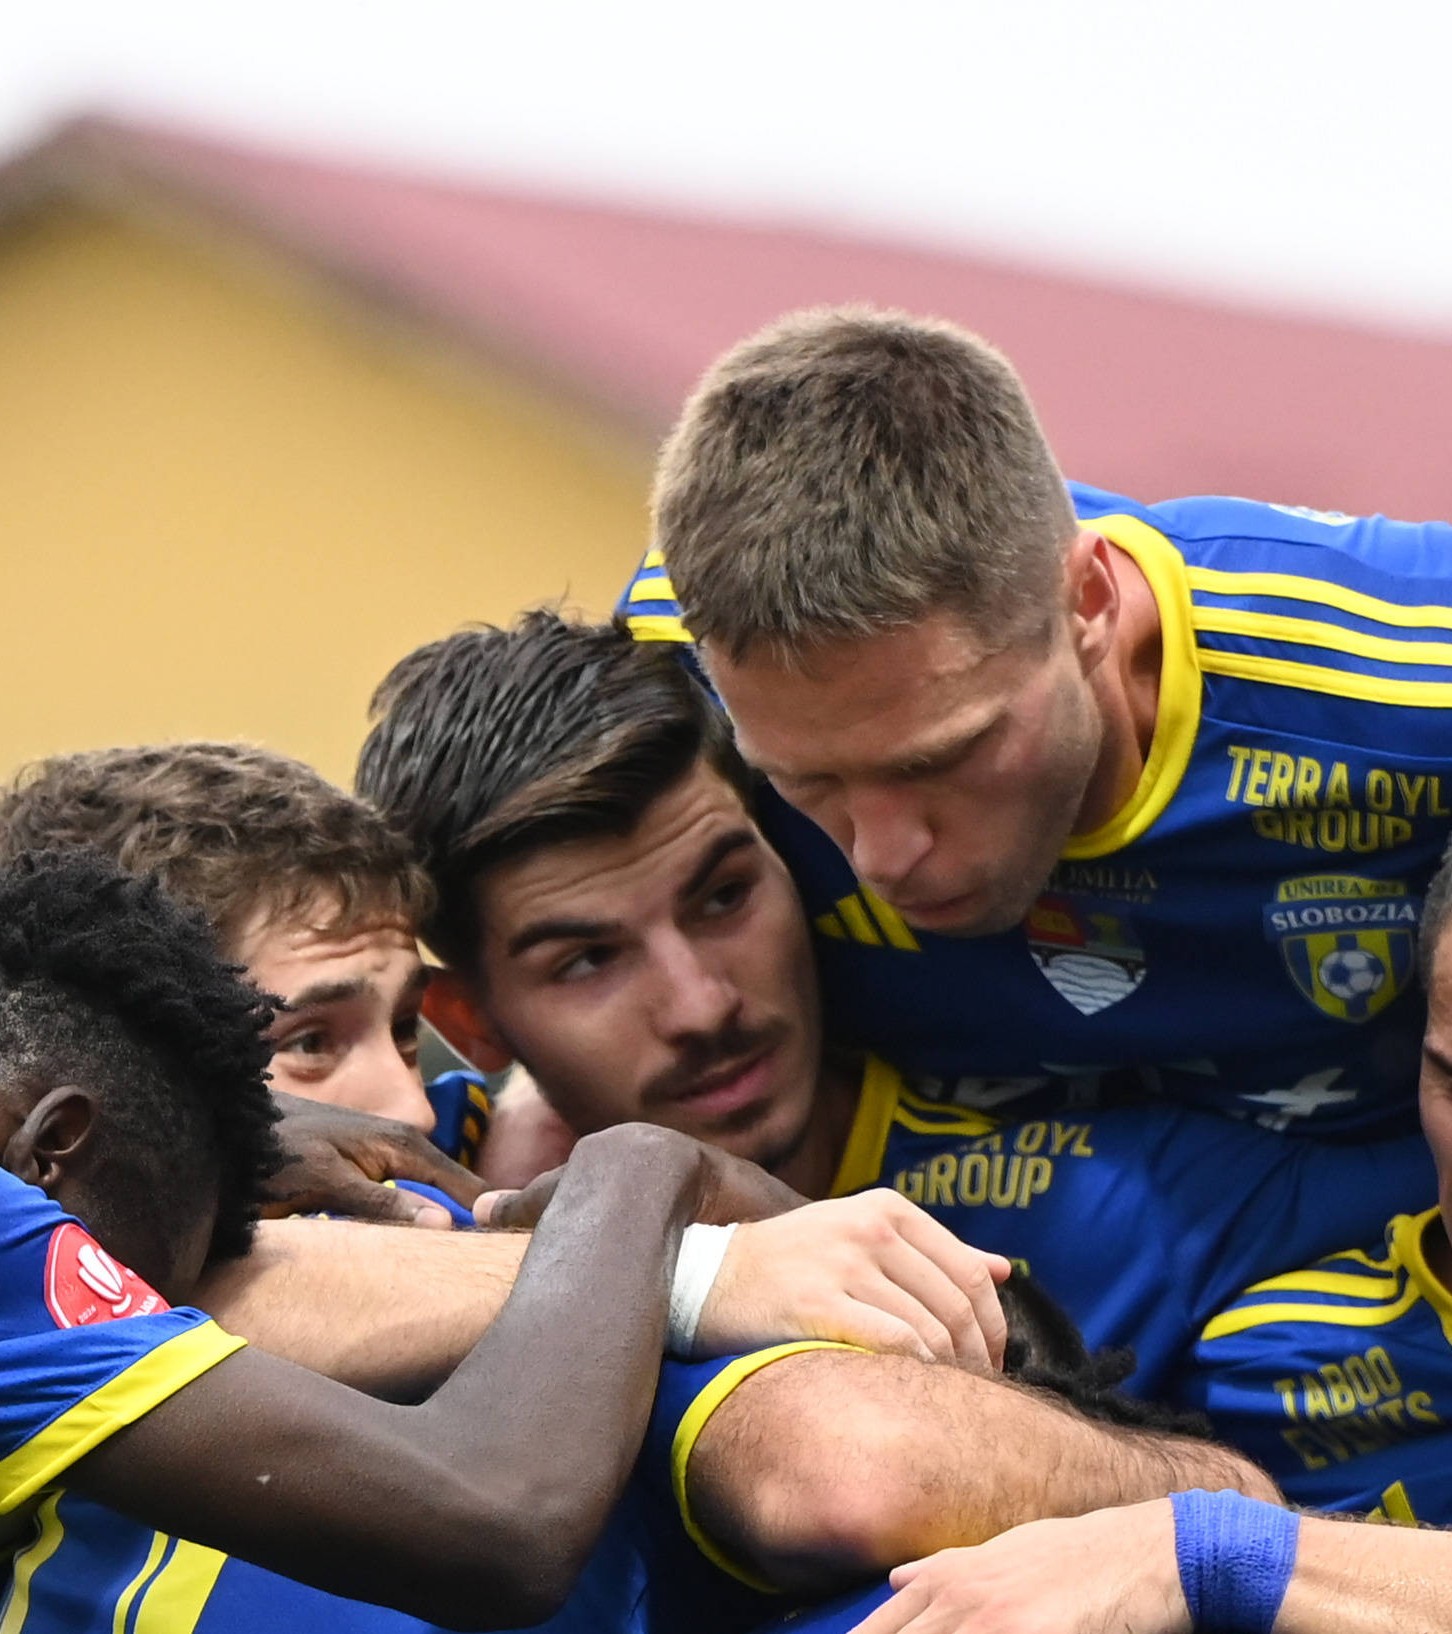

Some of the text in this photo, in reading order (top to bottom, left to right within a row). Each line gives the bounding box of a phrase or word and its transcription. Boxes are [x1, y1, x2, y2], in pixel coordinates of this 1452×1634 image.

[1225, 745, 1450, 816] TERRA OYL
[1252, 810, 1413, 853] GROUP
[1284, 879, 1363, 898] UNIREA
[1270, 903, 1416, 932] SLOBOZIA
[1012, 1121, 1094, 1157] OYL
[894, 1153, 1054, 1209] GROUP
[1273, 1345, 1403, 1422] TABOO
